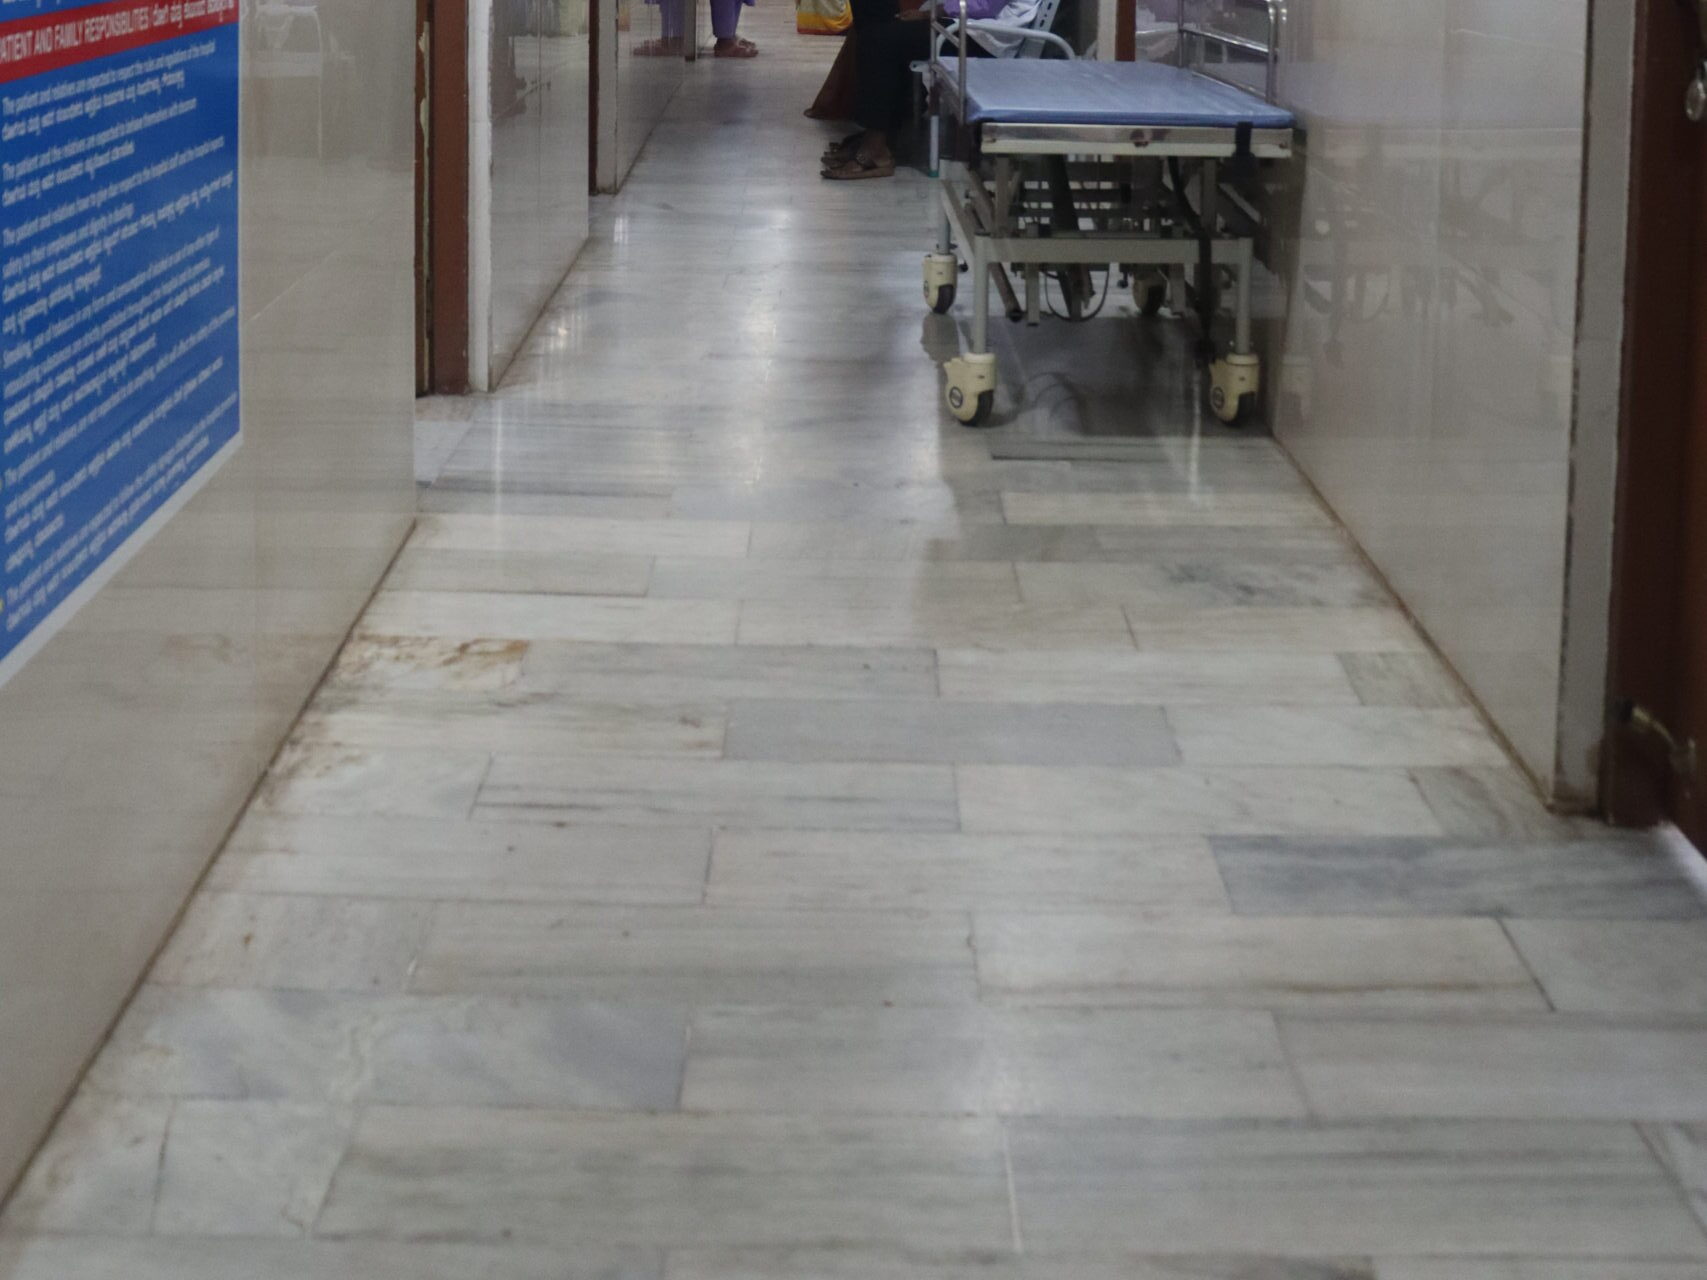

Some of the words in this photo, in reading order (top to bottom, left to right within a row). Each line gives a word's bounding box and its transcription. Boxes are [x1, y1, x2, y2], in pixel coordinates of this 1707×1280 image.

[0, 31, 32, 65] ATIENT
[34, 27, 52, 55] AND
[54, 21, 83, 51] FAMILY
